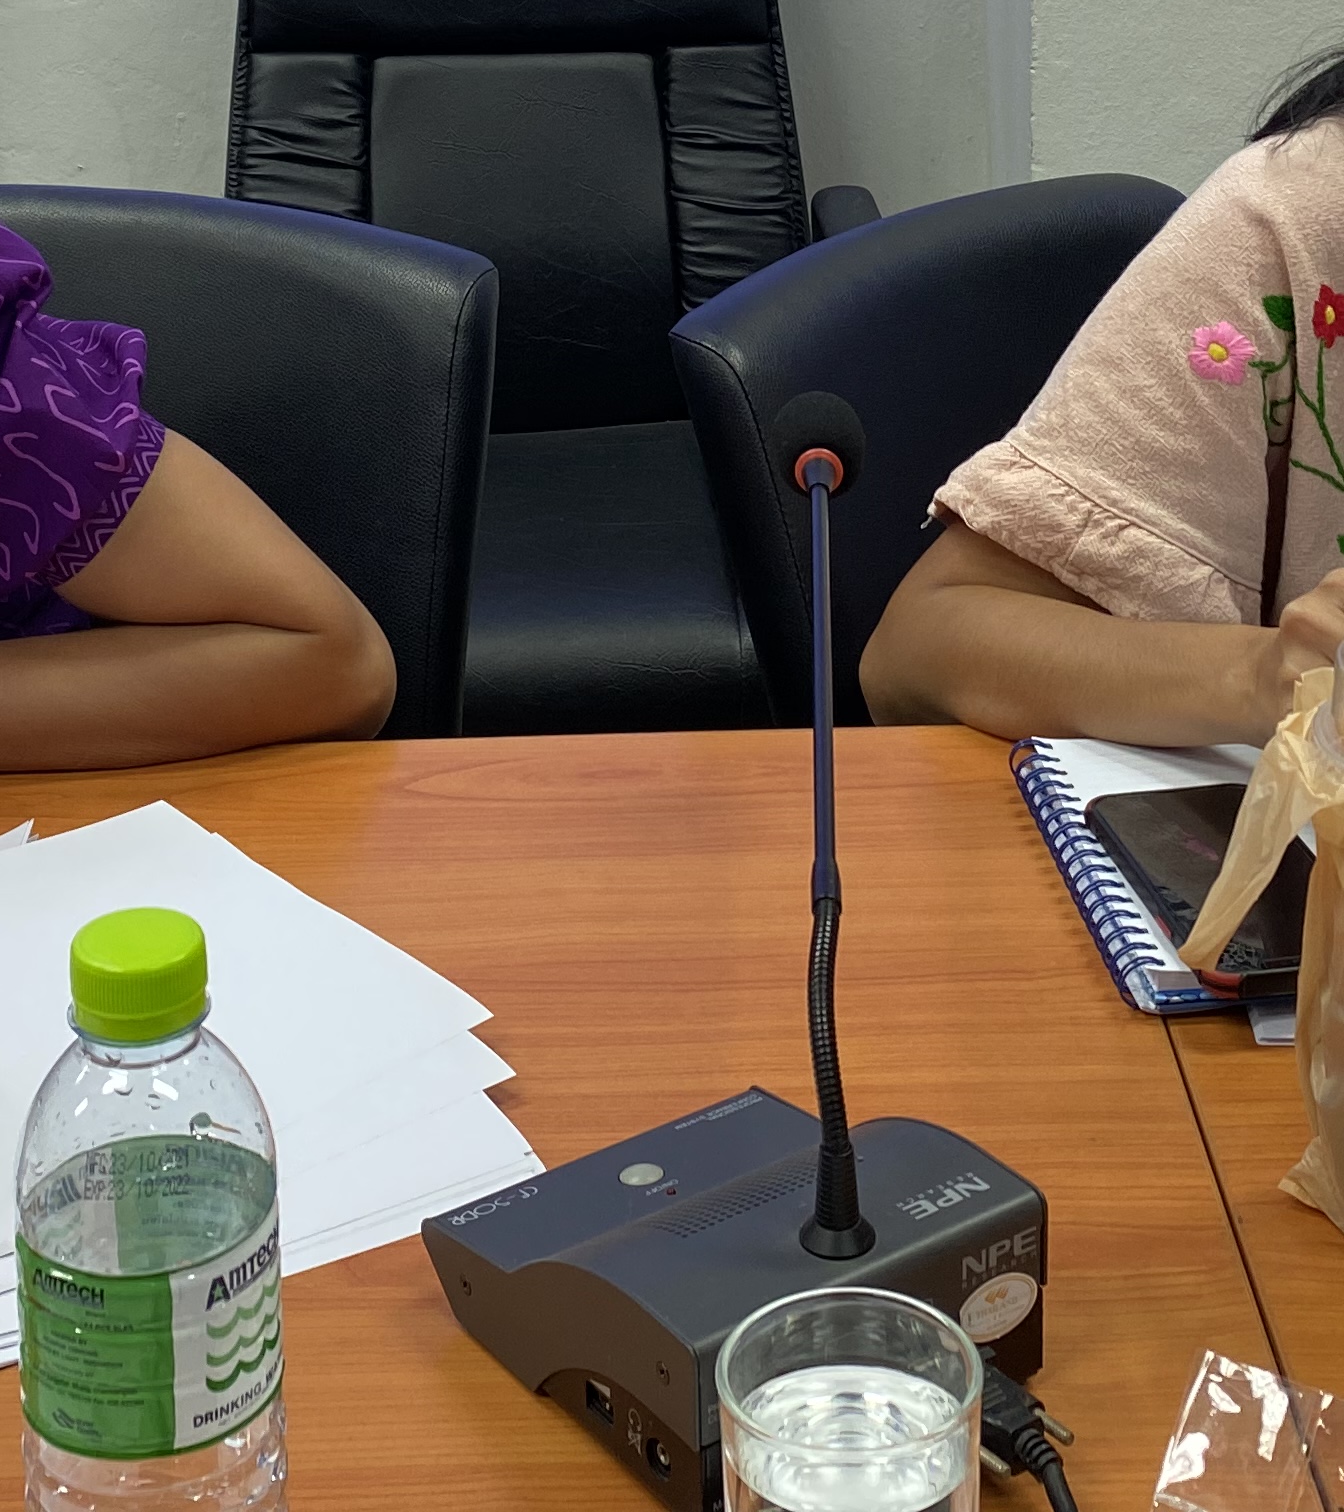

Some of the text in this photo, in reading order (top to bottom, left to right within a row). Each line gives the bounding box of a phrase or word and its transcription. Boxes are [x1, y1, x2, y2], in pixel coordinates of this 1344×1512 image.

[902, 1176, 991, 1220] NPE
[962, 1226, 1037, 1281] NPE
[193, 1380, 262, 1429] DRINKING
